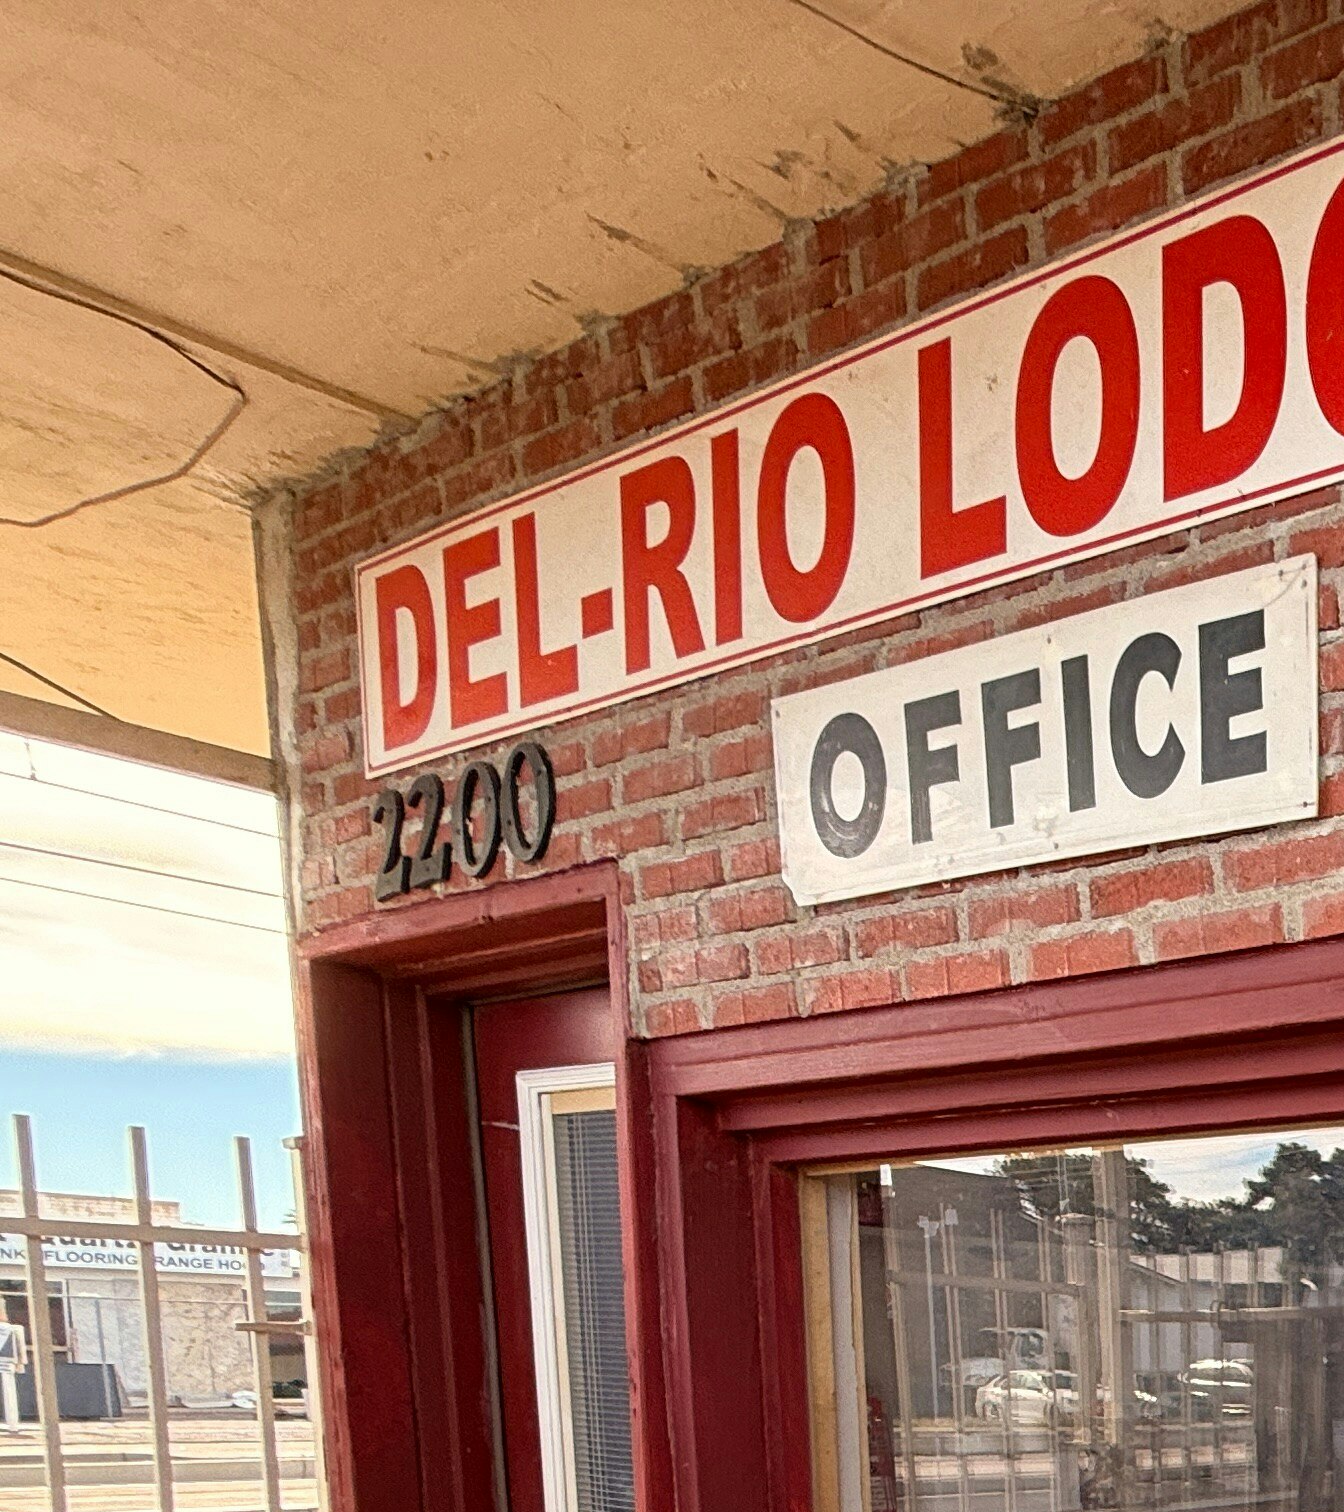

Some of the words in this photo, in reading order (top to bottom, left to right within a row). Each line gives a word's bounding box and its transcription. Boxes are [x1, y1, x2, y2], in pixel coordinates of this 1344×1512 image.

[375, 393, 856, 753] DEL-RIO
[373, 741, 557, 903] 2200
[809, 608, 1269, 860] OFFICE
[44, 1250, 138, 1266] FLOORING
[155, 1256, 214, 1270] RANGE
